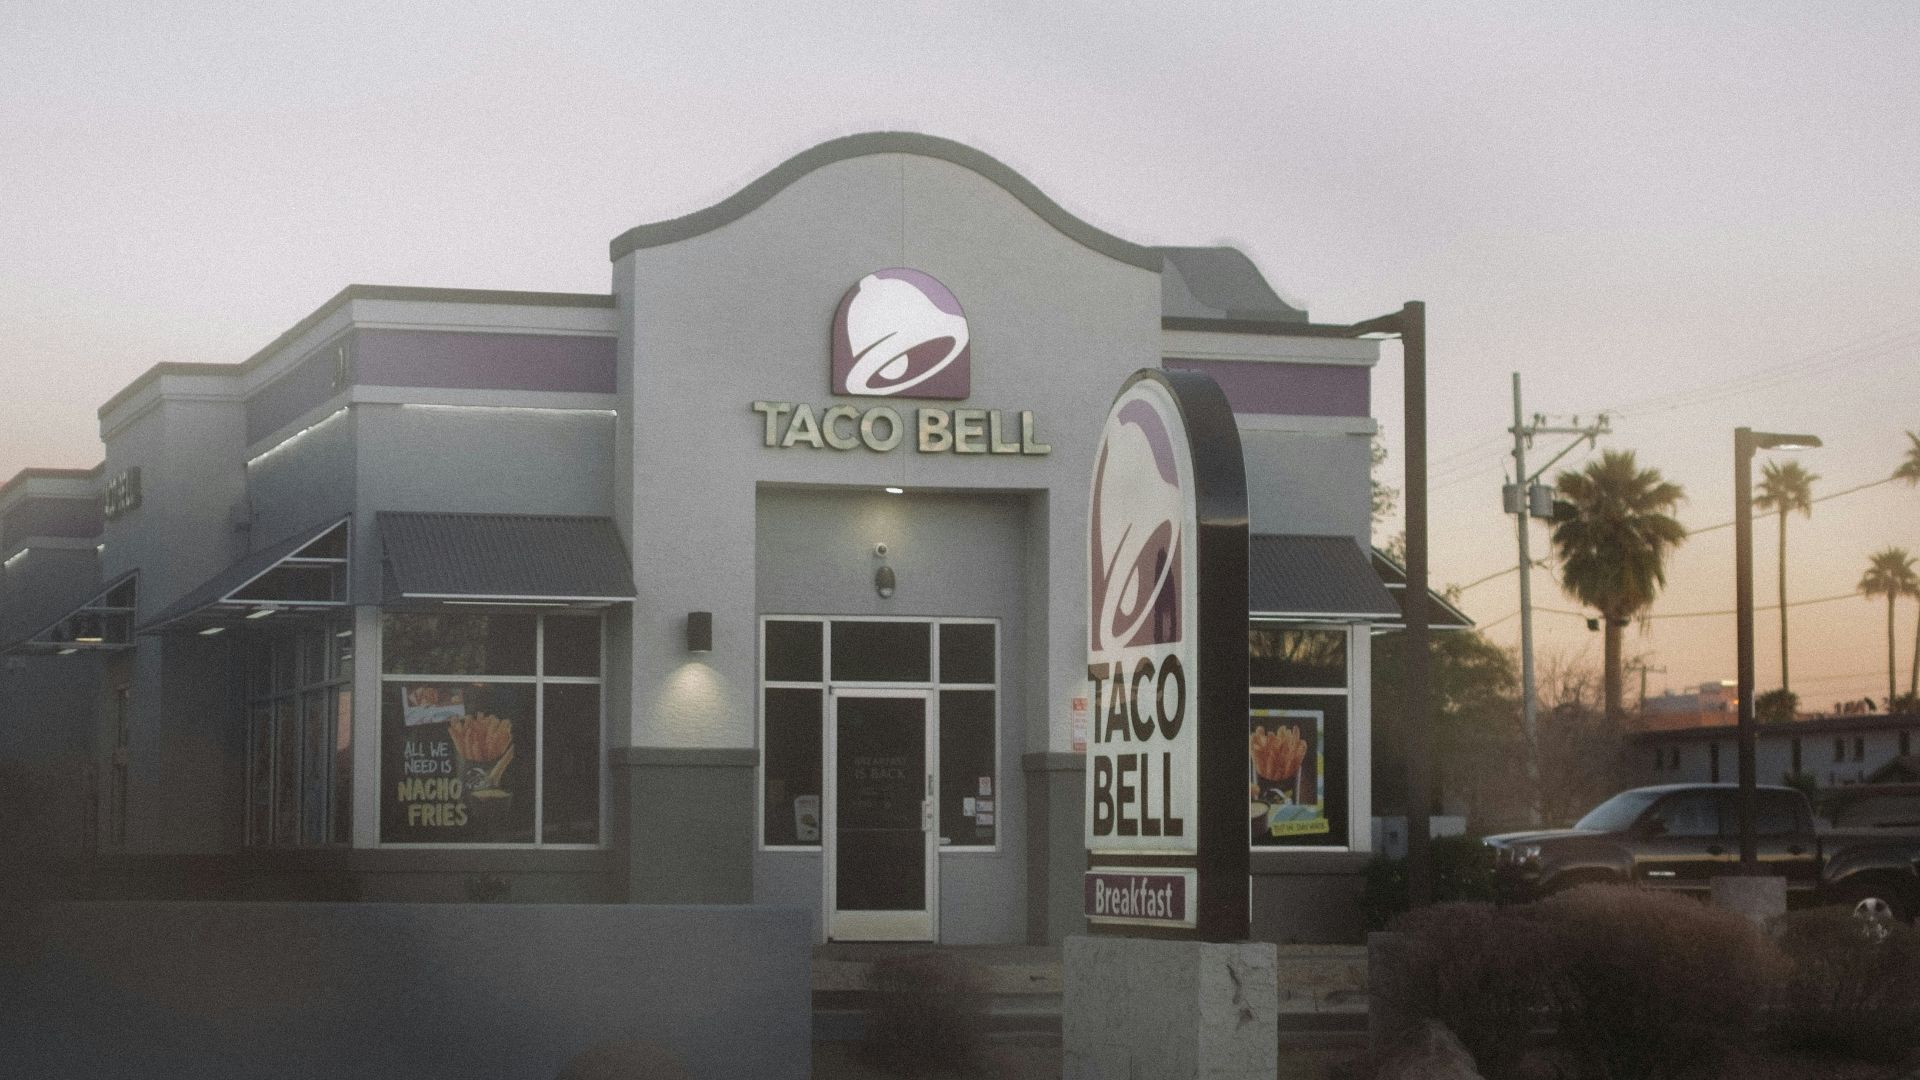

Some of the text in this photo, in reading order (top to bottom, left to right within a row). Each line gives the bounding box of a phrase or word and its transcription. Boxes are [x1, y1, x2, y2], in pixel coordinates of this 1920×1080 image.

[752, 400, 1052, 455] TACO BELL
[1087, 653, 1186, 744] TACO
[404, 741, 449, 758] ALL WE
[404, 760, 452, 775] NEED IS
[397, 777, 463, 802] NACHO
[1093, 751, 1184, 837] BELL
[407, 803, 468, 827] FRIES
[1094, 878, 1173, 919] Breakfast
